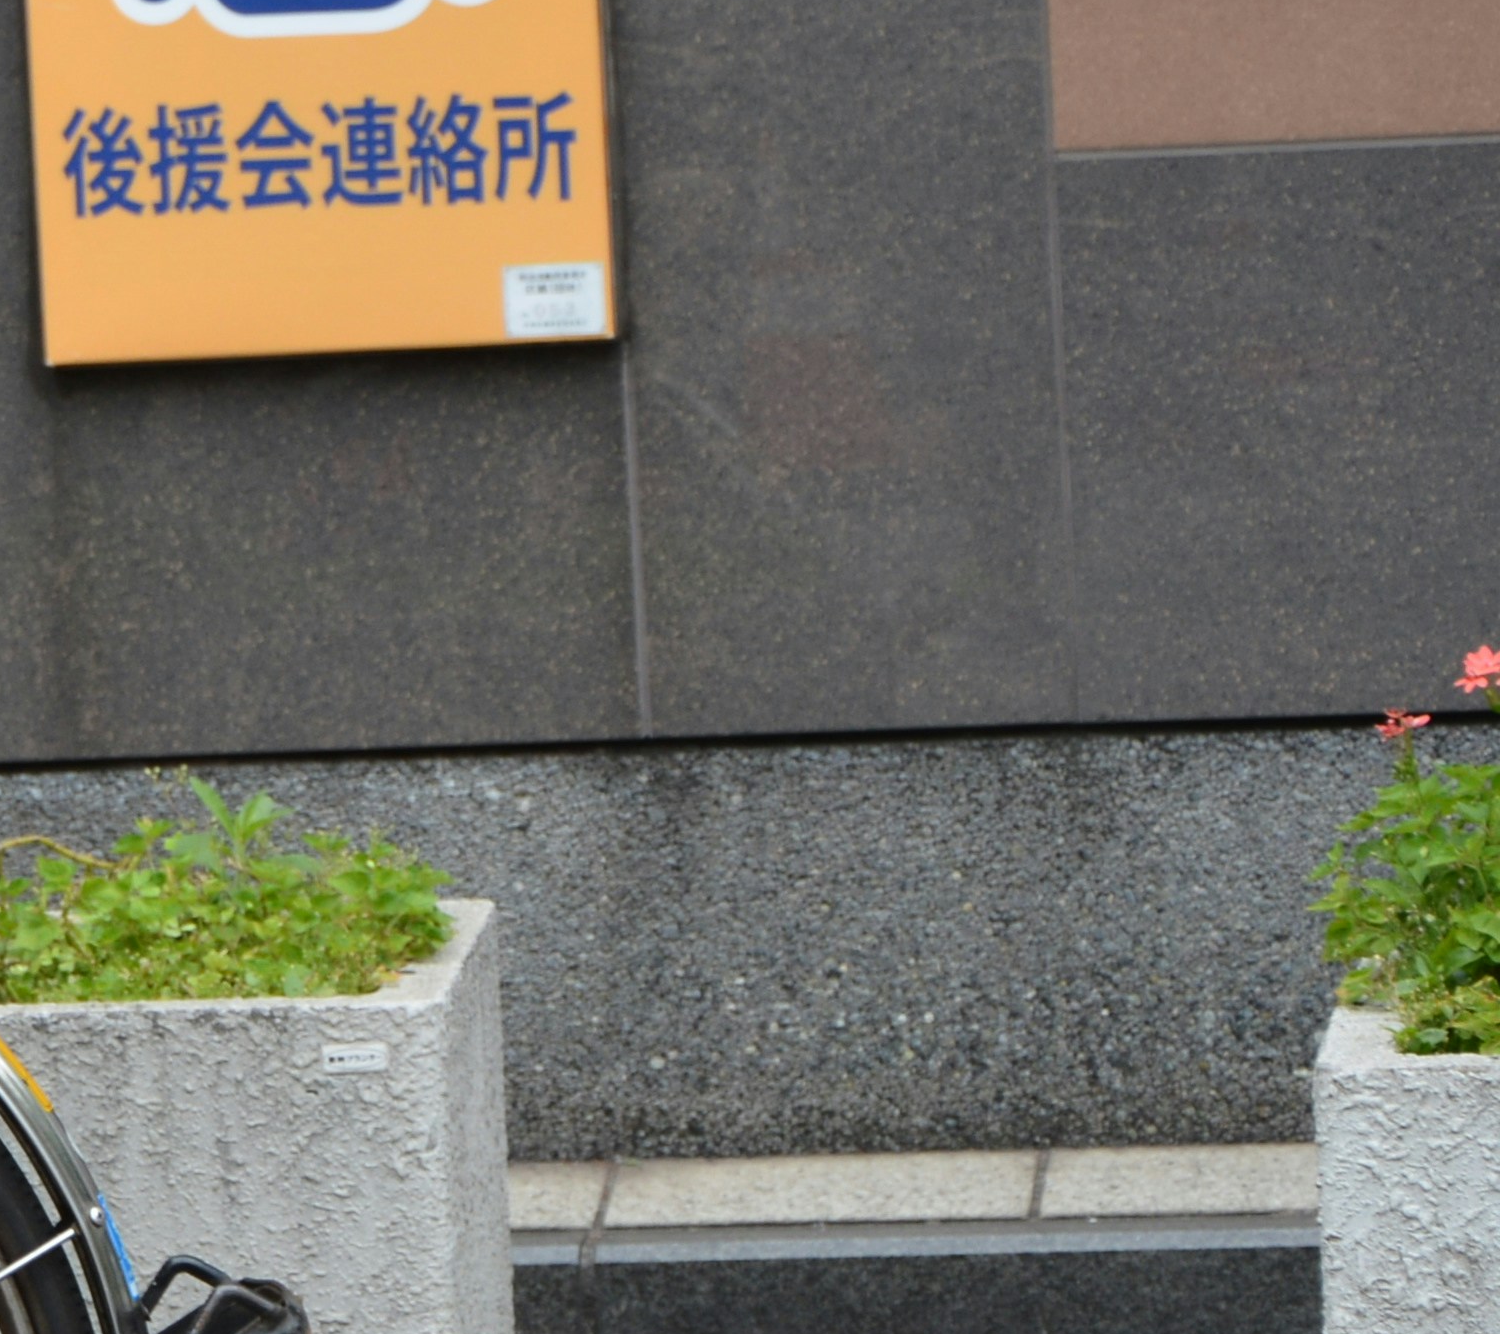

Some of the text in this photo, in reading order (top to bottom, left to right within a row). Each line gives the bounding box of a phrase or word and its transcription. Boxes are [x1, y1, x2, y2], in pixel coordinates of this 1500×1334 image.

[61, 91, 577, 219] 後援会連絡所
